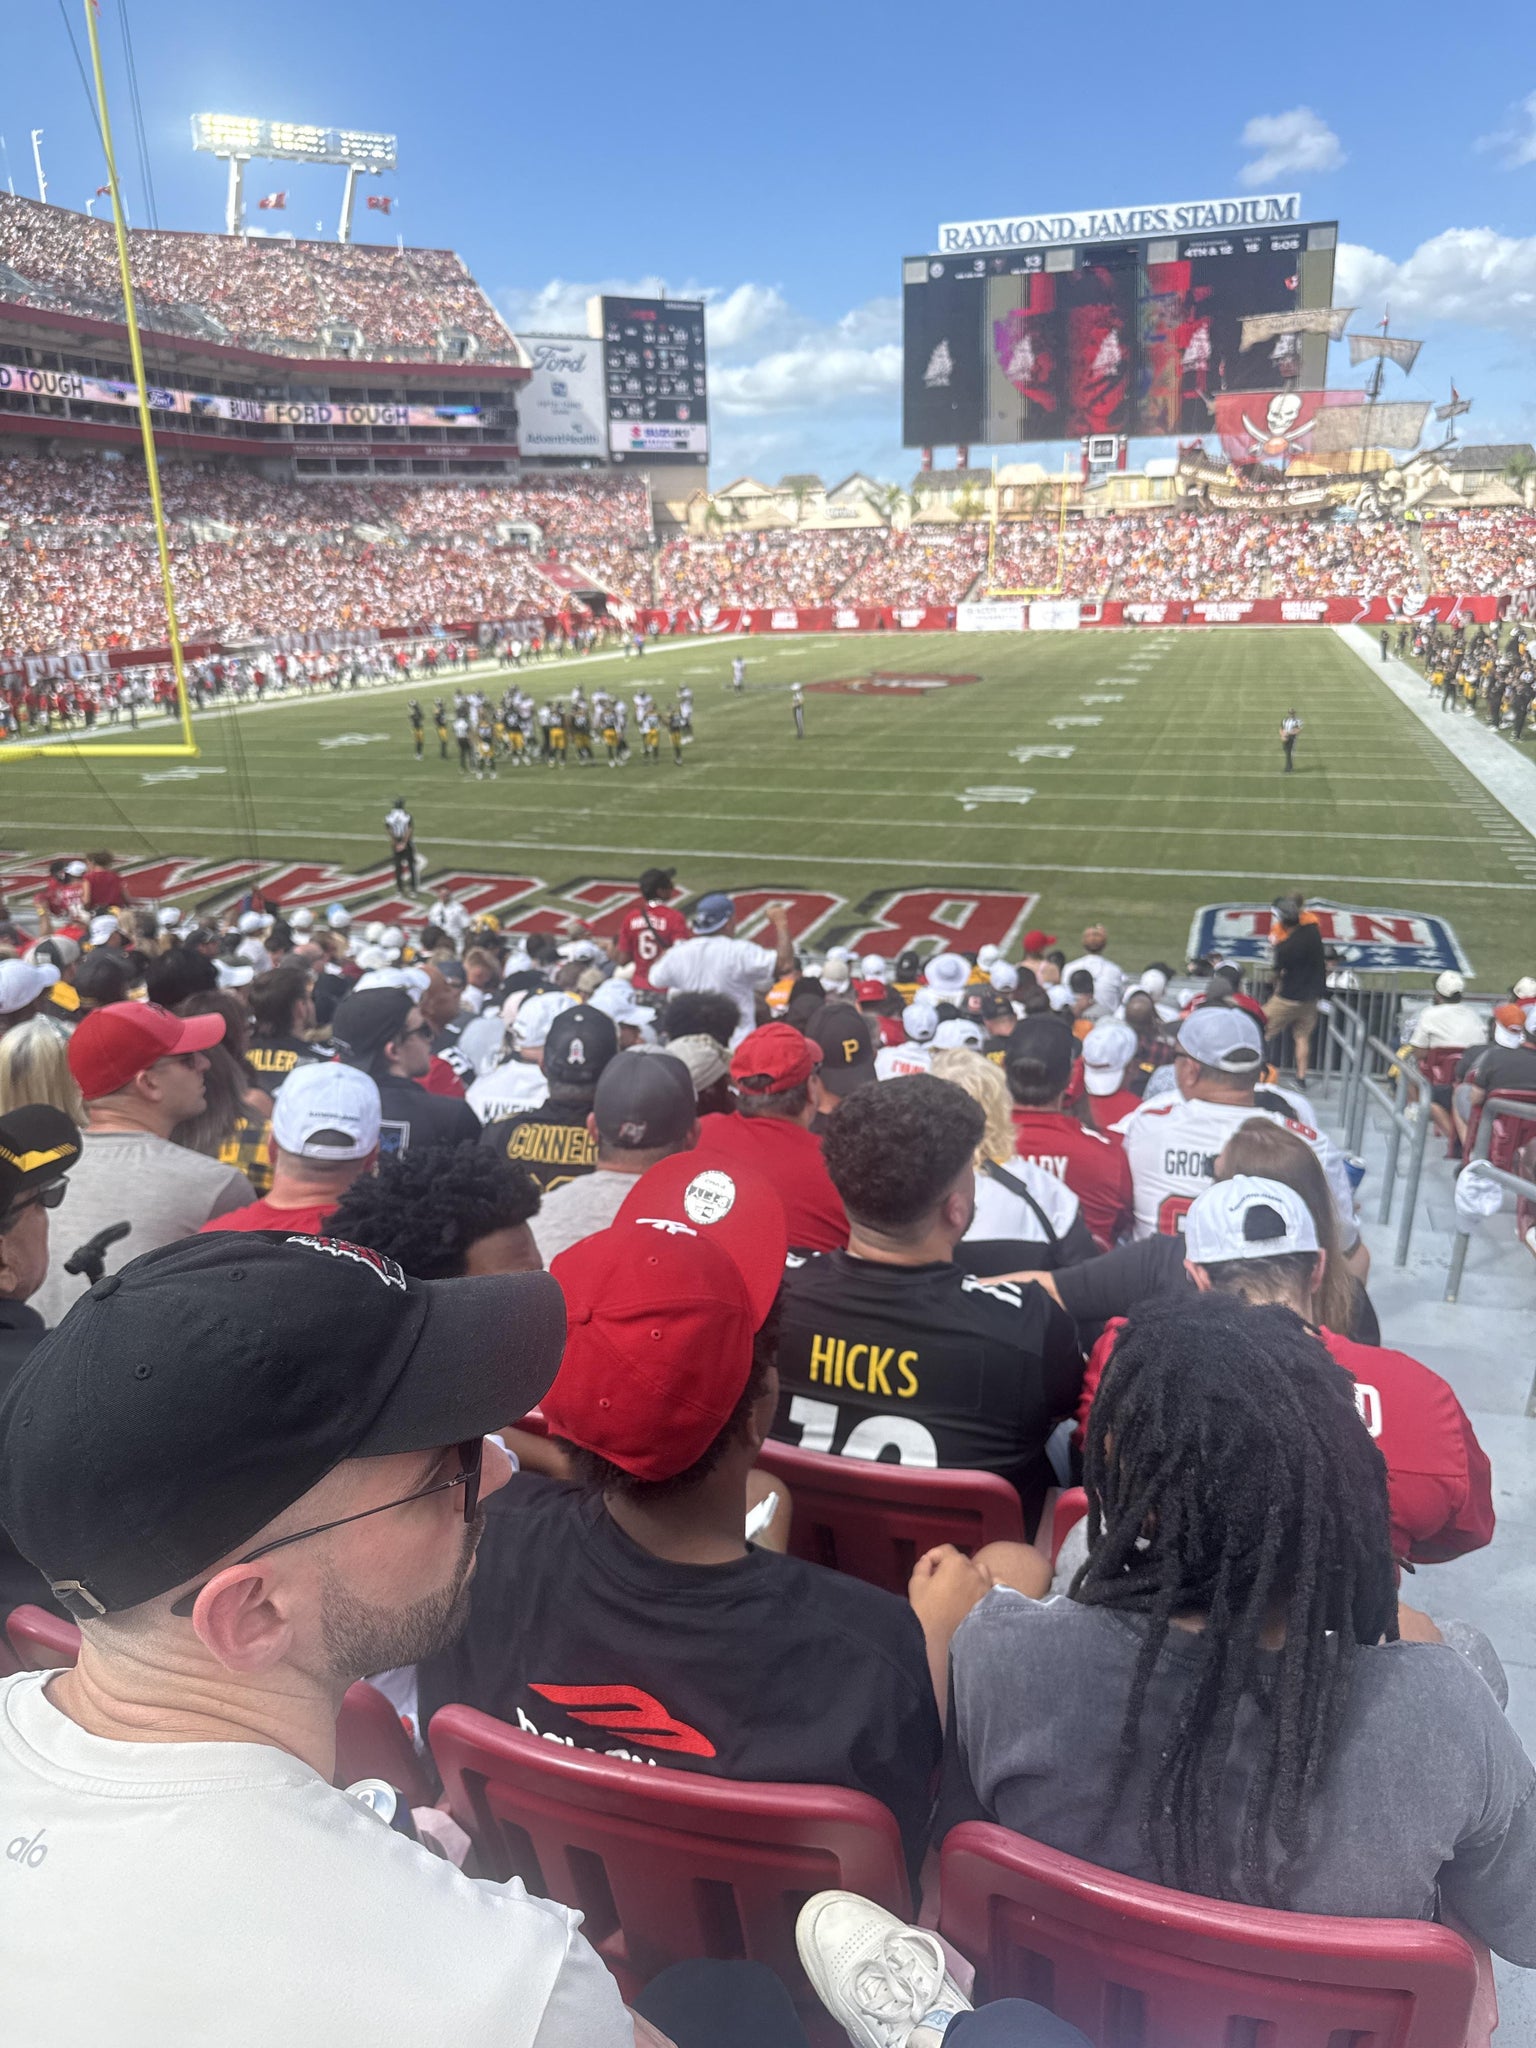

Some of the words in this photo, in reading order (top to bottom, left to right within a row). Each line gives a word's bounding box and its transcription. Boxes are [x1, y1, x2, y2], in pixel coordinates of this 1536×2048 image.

[944, 217, 1076, 250] RAYMOND
[1080, 208, 1168, 239] JAMES
[1173, 196, 1297, 229] STADIUM
[532, 344, 587, 374] Ford
[16, 369, 85, 398] TOUGH
[229, 400, 267, 423] BUILT
[275, 404, 333, 424] FORD
[340, 405, 410, 426] TOUGH
[638, 929, 658, 960] 6
[842, 1038, 860, 1063] P
[506, 1122, 599, 1166] CONNER
[809, 1334, 920, 1398] HICKS
[6, 1828, 48, 1868] alo
